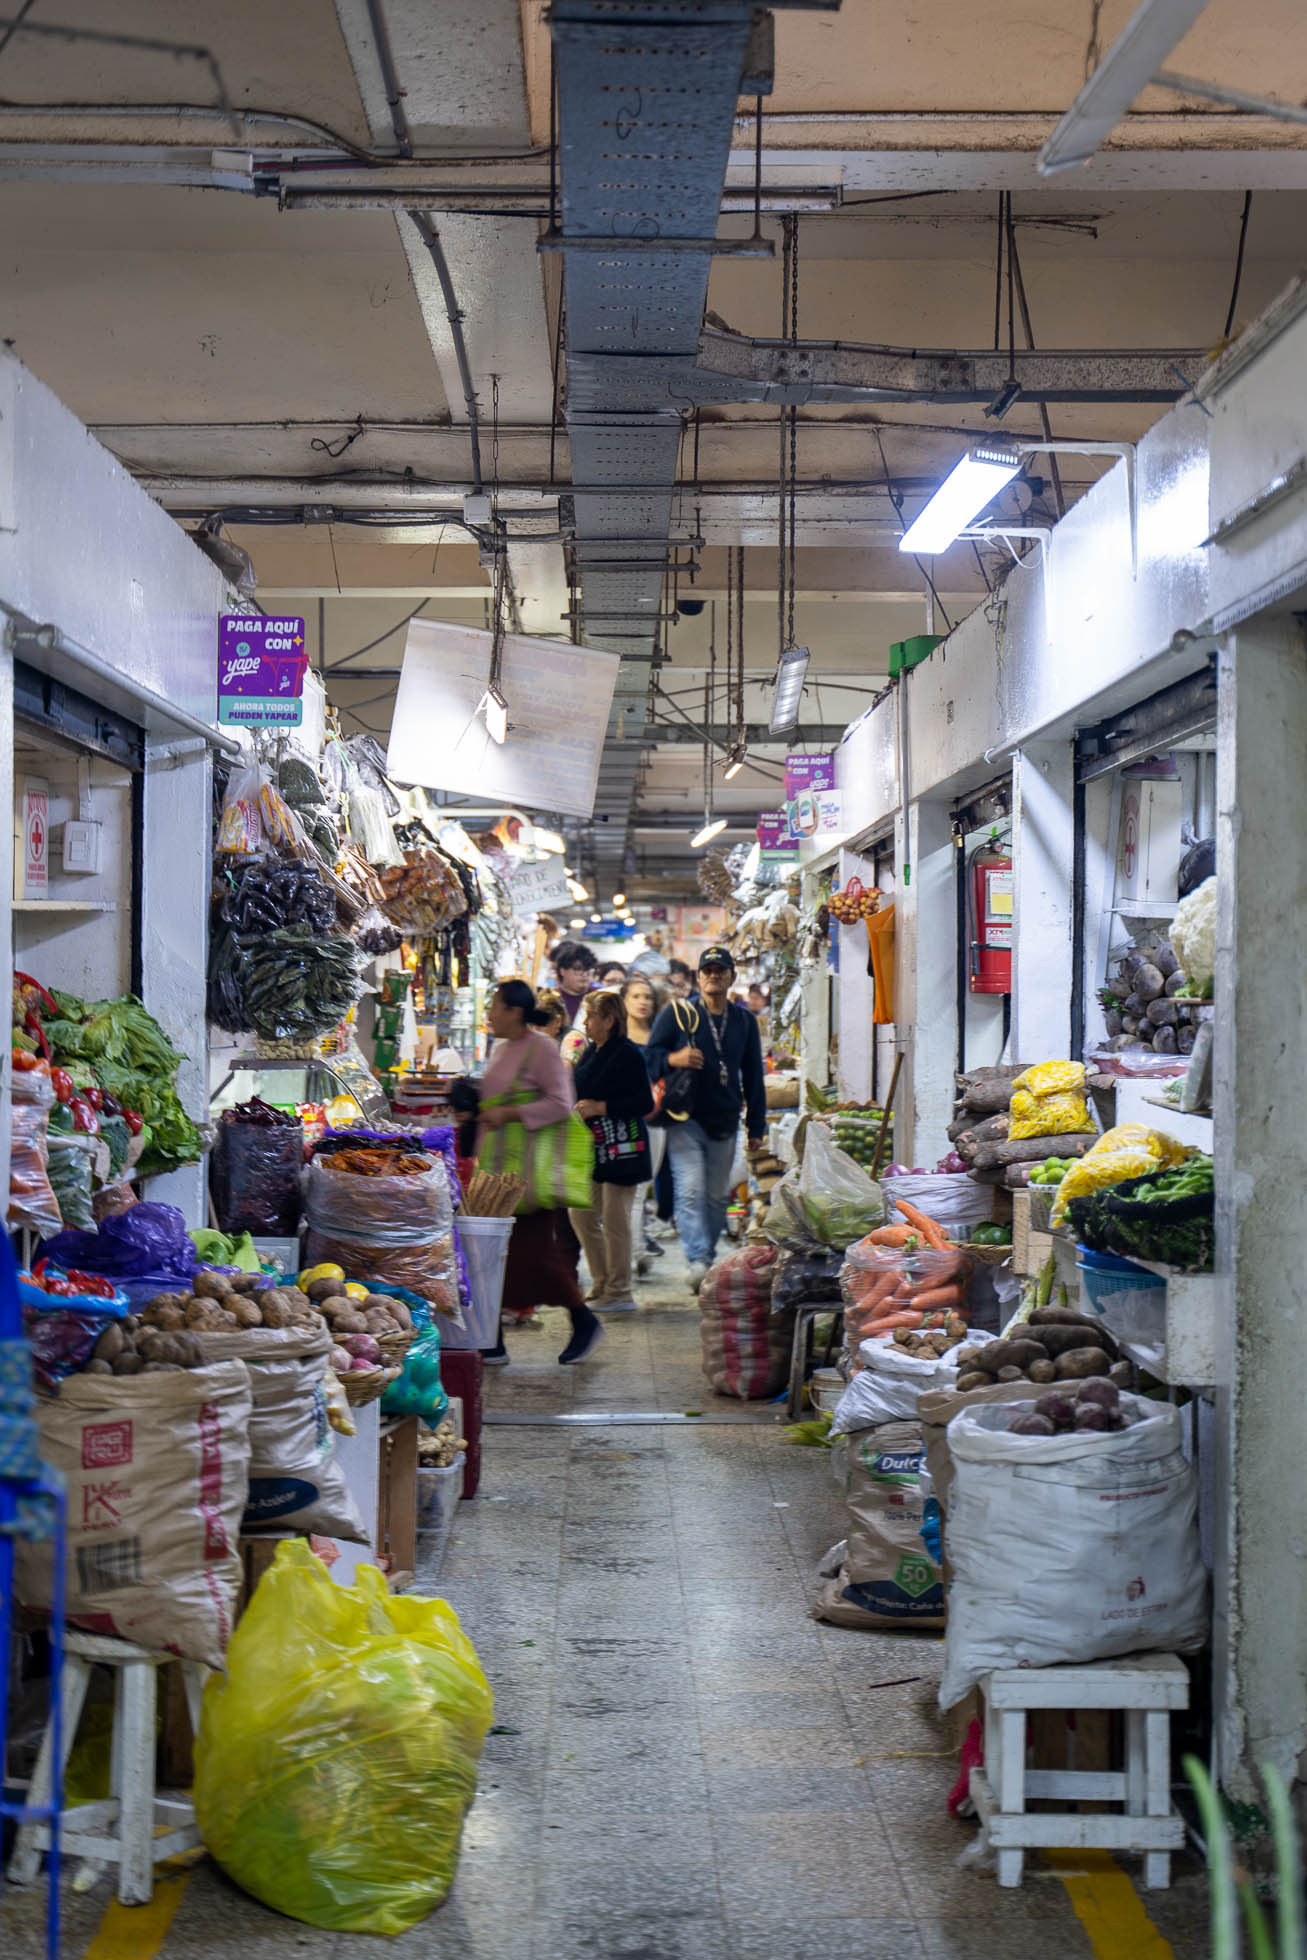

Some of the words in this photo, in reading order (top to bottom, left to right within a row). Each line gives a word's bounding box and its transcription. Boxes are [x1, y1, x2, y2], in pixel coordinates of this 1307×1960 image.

[227, 621, 262, 632] PAGA
[265, 620, 299, 634] AQUÍ
[265, 638, 292, 650] CON
[222, 657, 261, 685] yape
[233, 703, 264, 711] AHORA
[228, 712, 263, 720] PUEDEN
[881, 1457, 921, 1470] Dulc
[902, 1565, 928, 1583] 50
